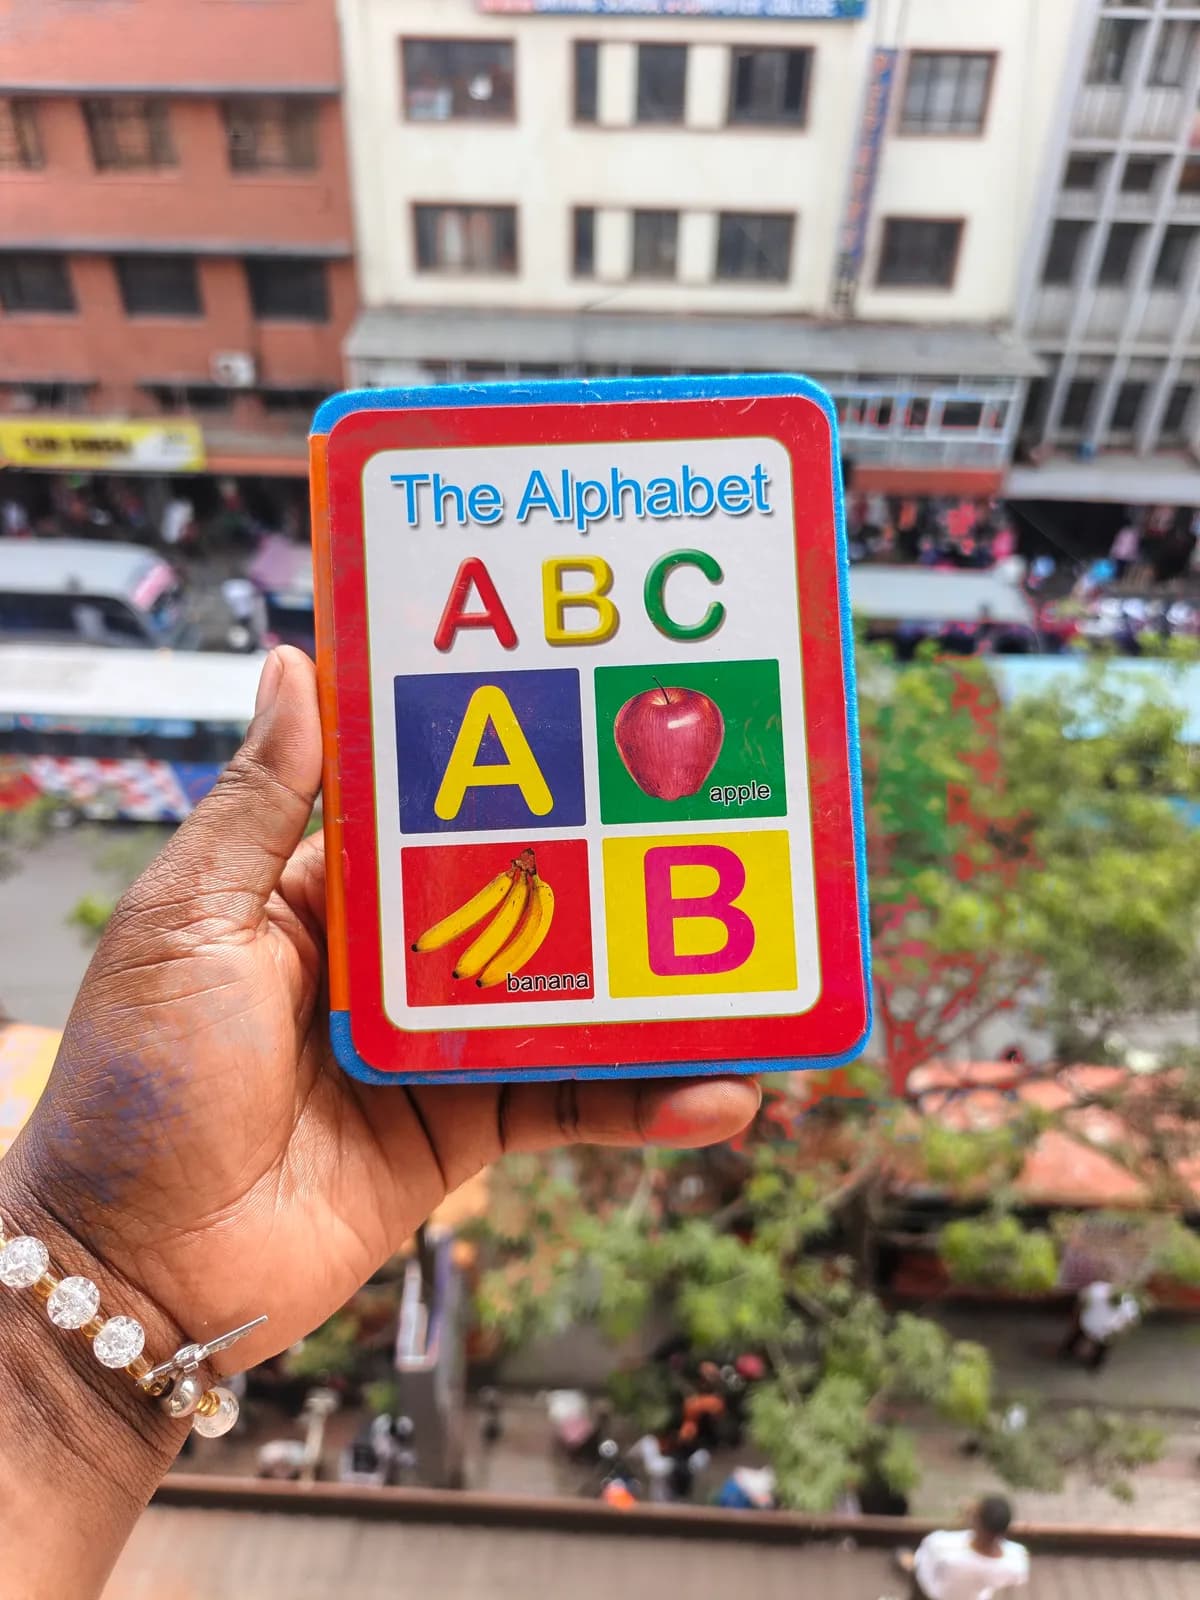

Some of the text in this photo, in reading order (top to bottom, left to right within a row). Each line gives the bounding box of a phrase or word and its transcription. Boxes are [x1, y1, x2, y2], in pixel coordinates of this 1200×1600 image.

[390, 463, 773, 532] The Alphabet
[433, 548, 725, 652] A B C
[434, 684, 554, 821] A
[709, 781, 771, 805] apple
[643, 844, 756, 977] B
[506, 972, 590, 993] banana
